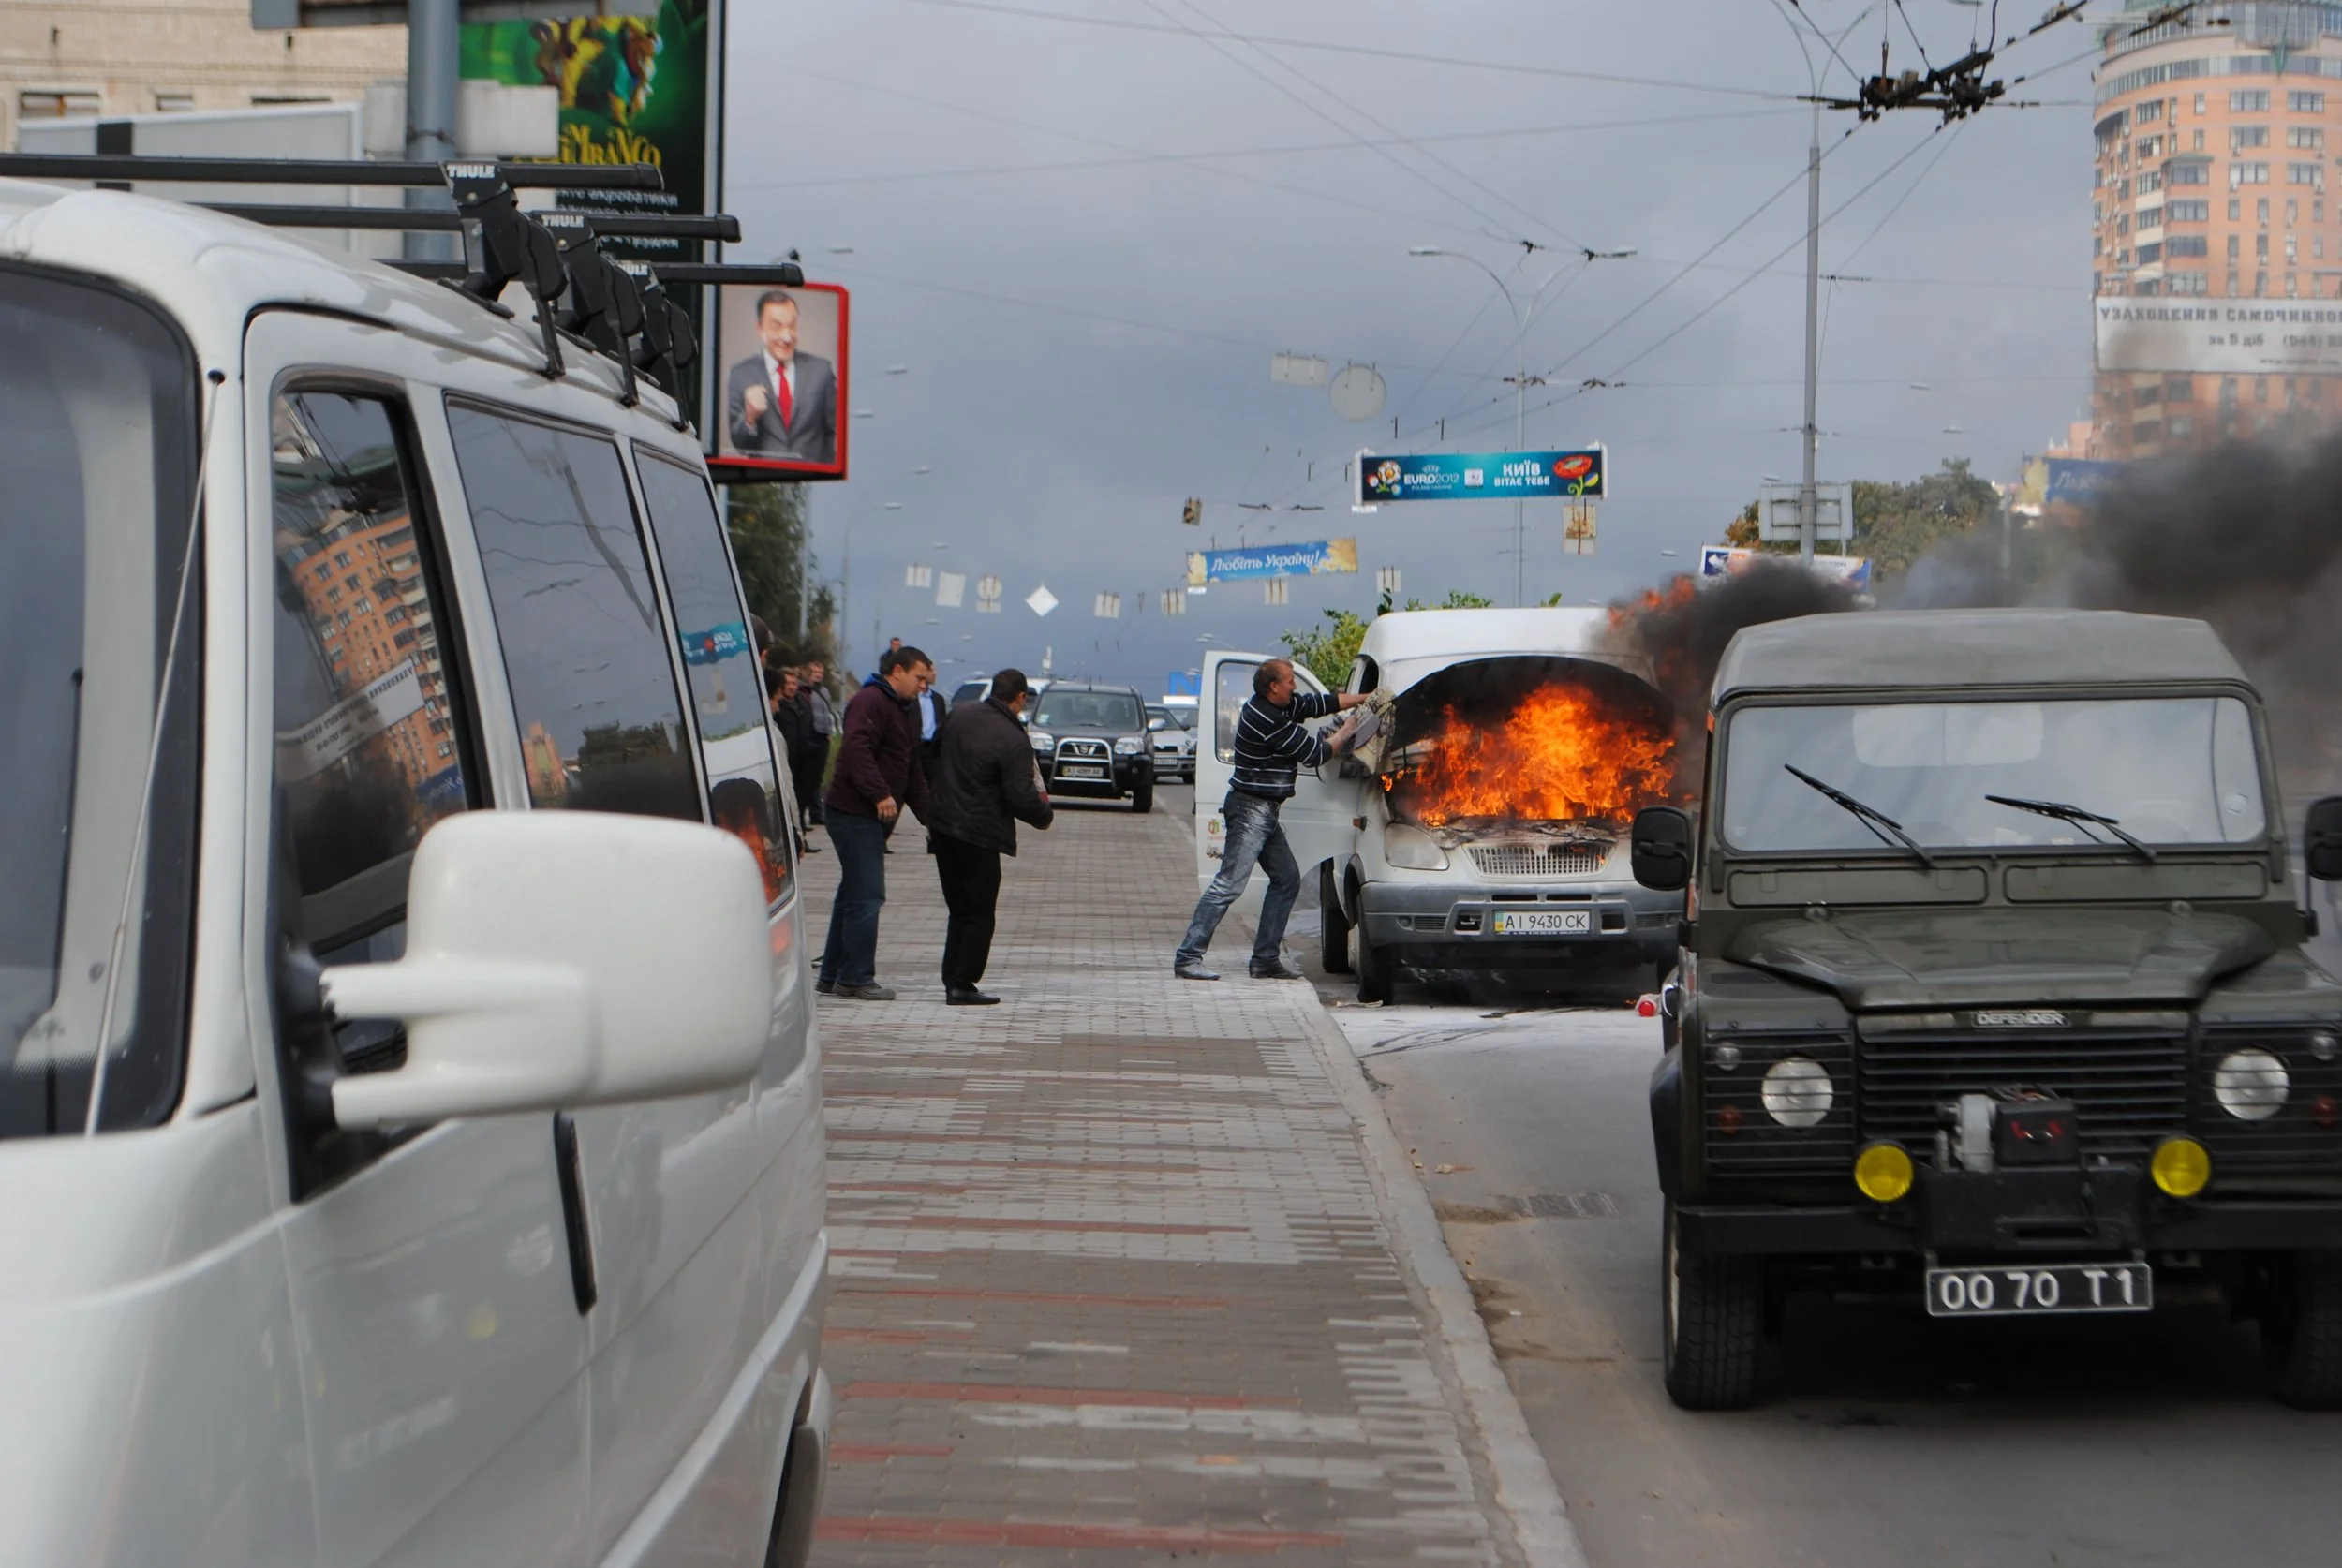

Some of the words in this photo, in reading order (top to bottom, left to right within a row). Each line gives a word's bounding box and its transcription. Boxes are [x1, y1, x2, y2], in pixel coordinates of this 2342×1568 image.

[447, 165, 495, 178] THULE
[541, 214, 584, 228] THULE
[618, 263, 648, 275] ULE
[1503, 459, 1541, 477] КИЇВ
[1494, 477, 1522, 487] ВІТАЄ
[1525, 475, 1550, 486] ТЕБЕ
[1211, 557, 1262, 571] Любіть
[1265, 550, 1320, 568] Україну!
[1528, 914, 1562, 929] 9430
[1565, 914, 1586, 928] CK
[1977, 1012, 2066, 1026] DEFENDER
[2006, 1270, 2060, 1309] 70
[2083, 1268, 2134, 1307] T1
